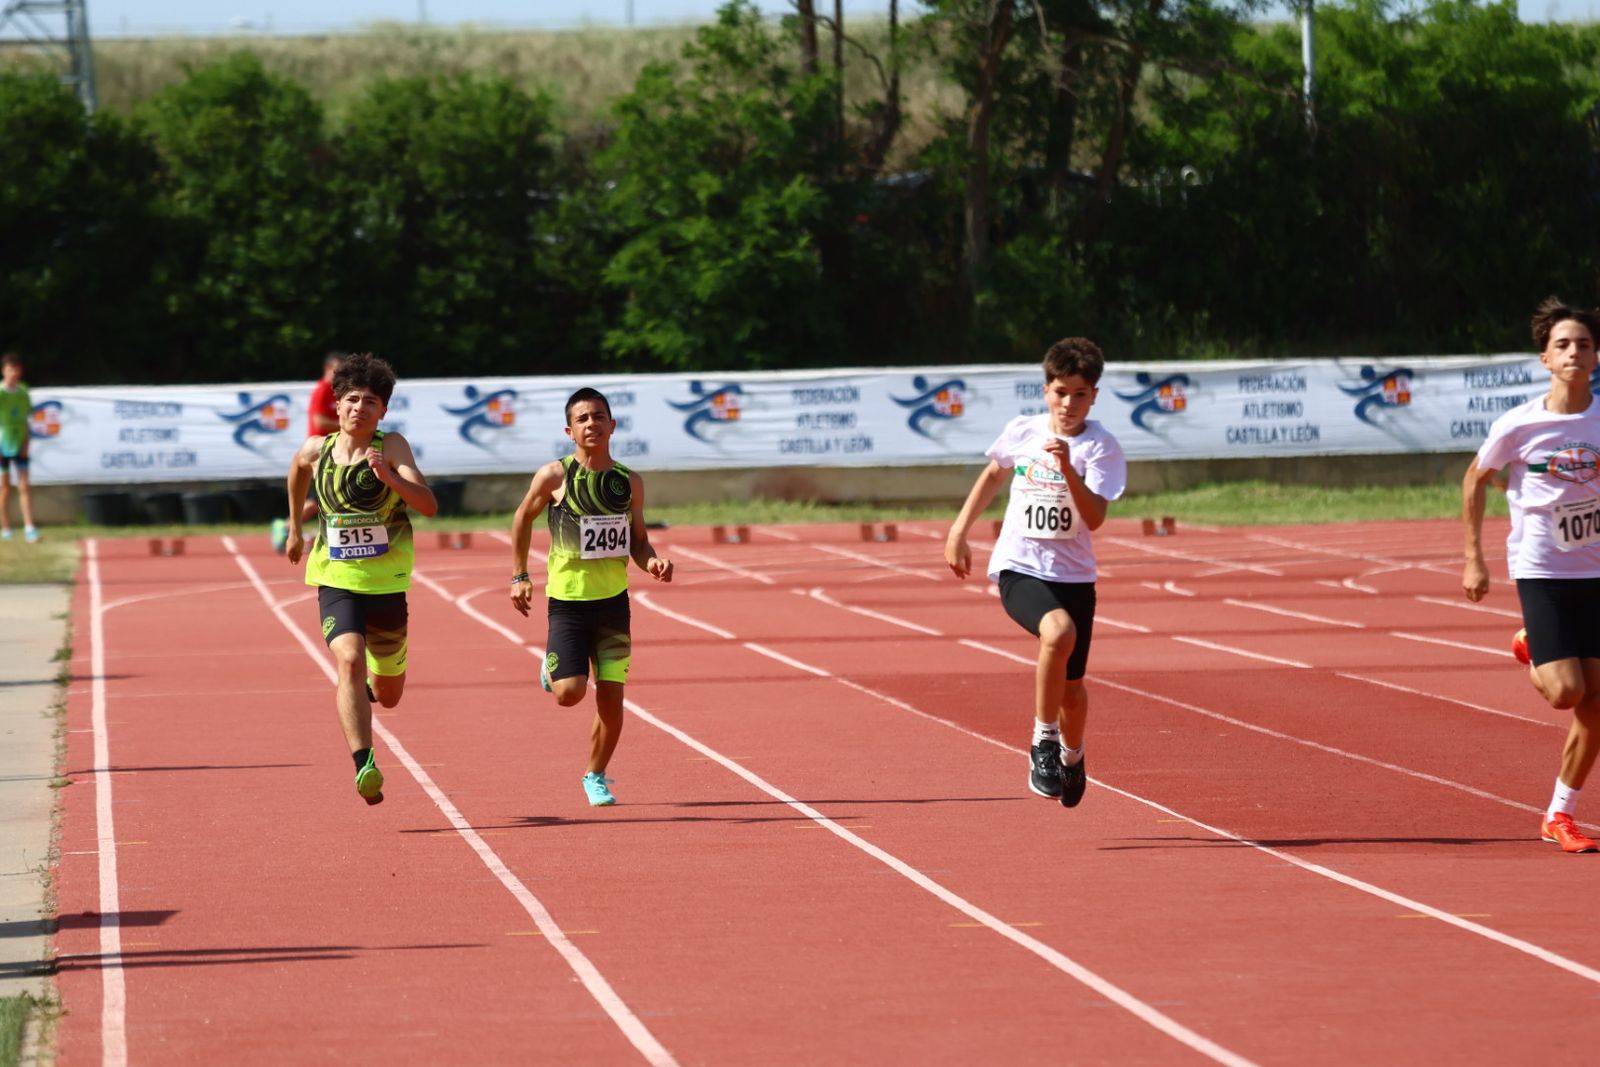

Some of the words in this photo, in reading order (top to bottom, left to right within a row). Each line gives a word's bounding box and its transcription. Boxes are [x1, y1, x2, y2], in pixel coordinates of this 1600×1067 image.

[1237, 373, 1307, 393] FEDERACIÓN
[1463, 366, 1533, 388] FEDERACIÓN
[1242, 400, 1304, 419] ATLETISMO
[1225, 425, 1279, 444] CASTILLA
[1279, 426, 1288, 442] Y
[1290, 421, 1320, 442] LEÓN
[1450, 419, 1491, 439] CASTIL
[1025, 504, 1072, 531] 1069
[1558, 509, 1600, 542] 1070
[339, 528, 373, 545] 515
[584, 526, 627, 551] 2494
